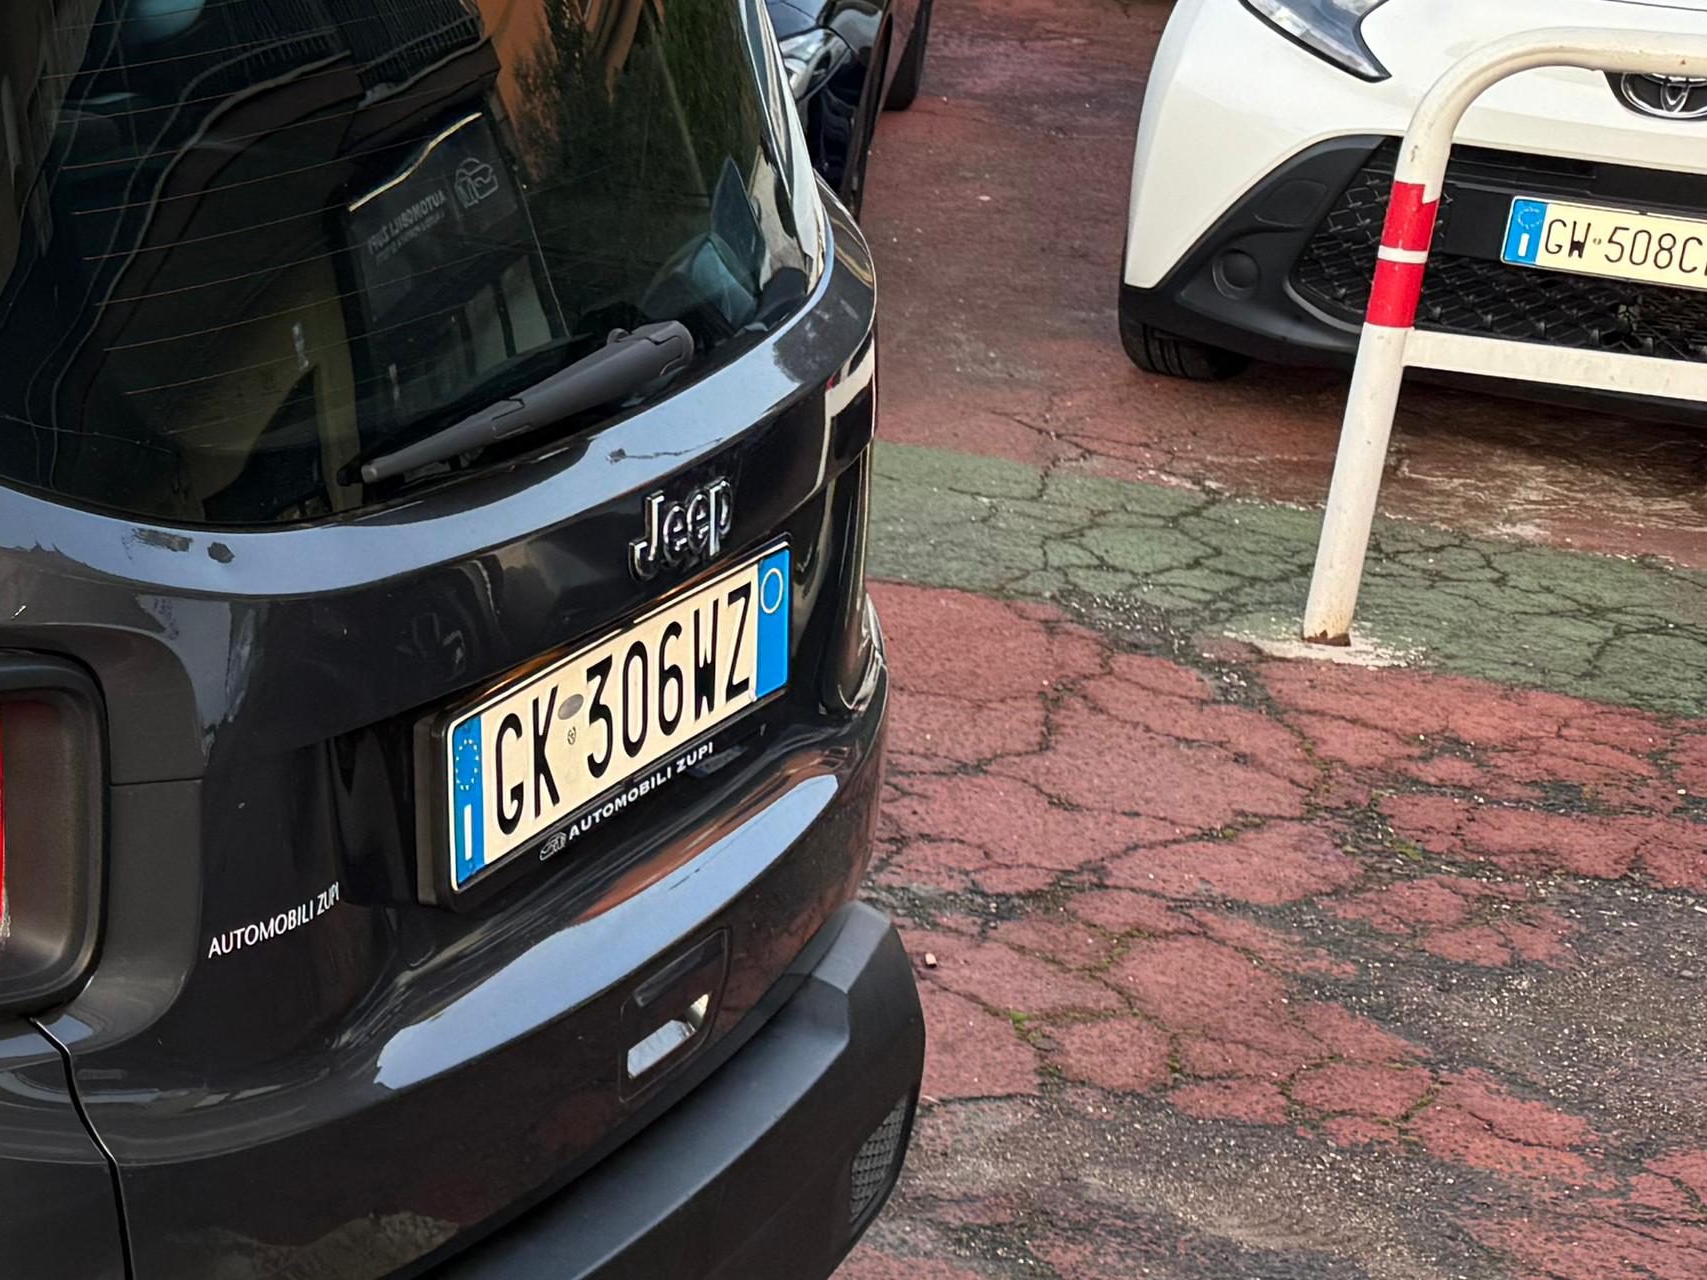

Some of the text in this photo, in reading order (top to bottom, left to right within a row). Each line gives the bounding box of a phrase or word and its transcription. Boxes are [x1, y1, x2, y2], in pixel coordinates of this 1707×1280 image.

[1604, 226, 1707, 277] 508C
[626, 475, 734, 583] Jeep
[568, 741, 714, 842] AUTOMOBILI ZUPI
[207, 880, 340, 959] AUTOMOBILI ZUPI
